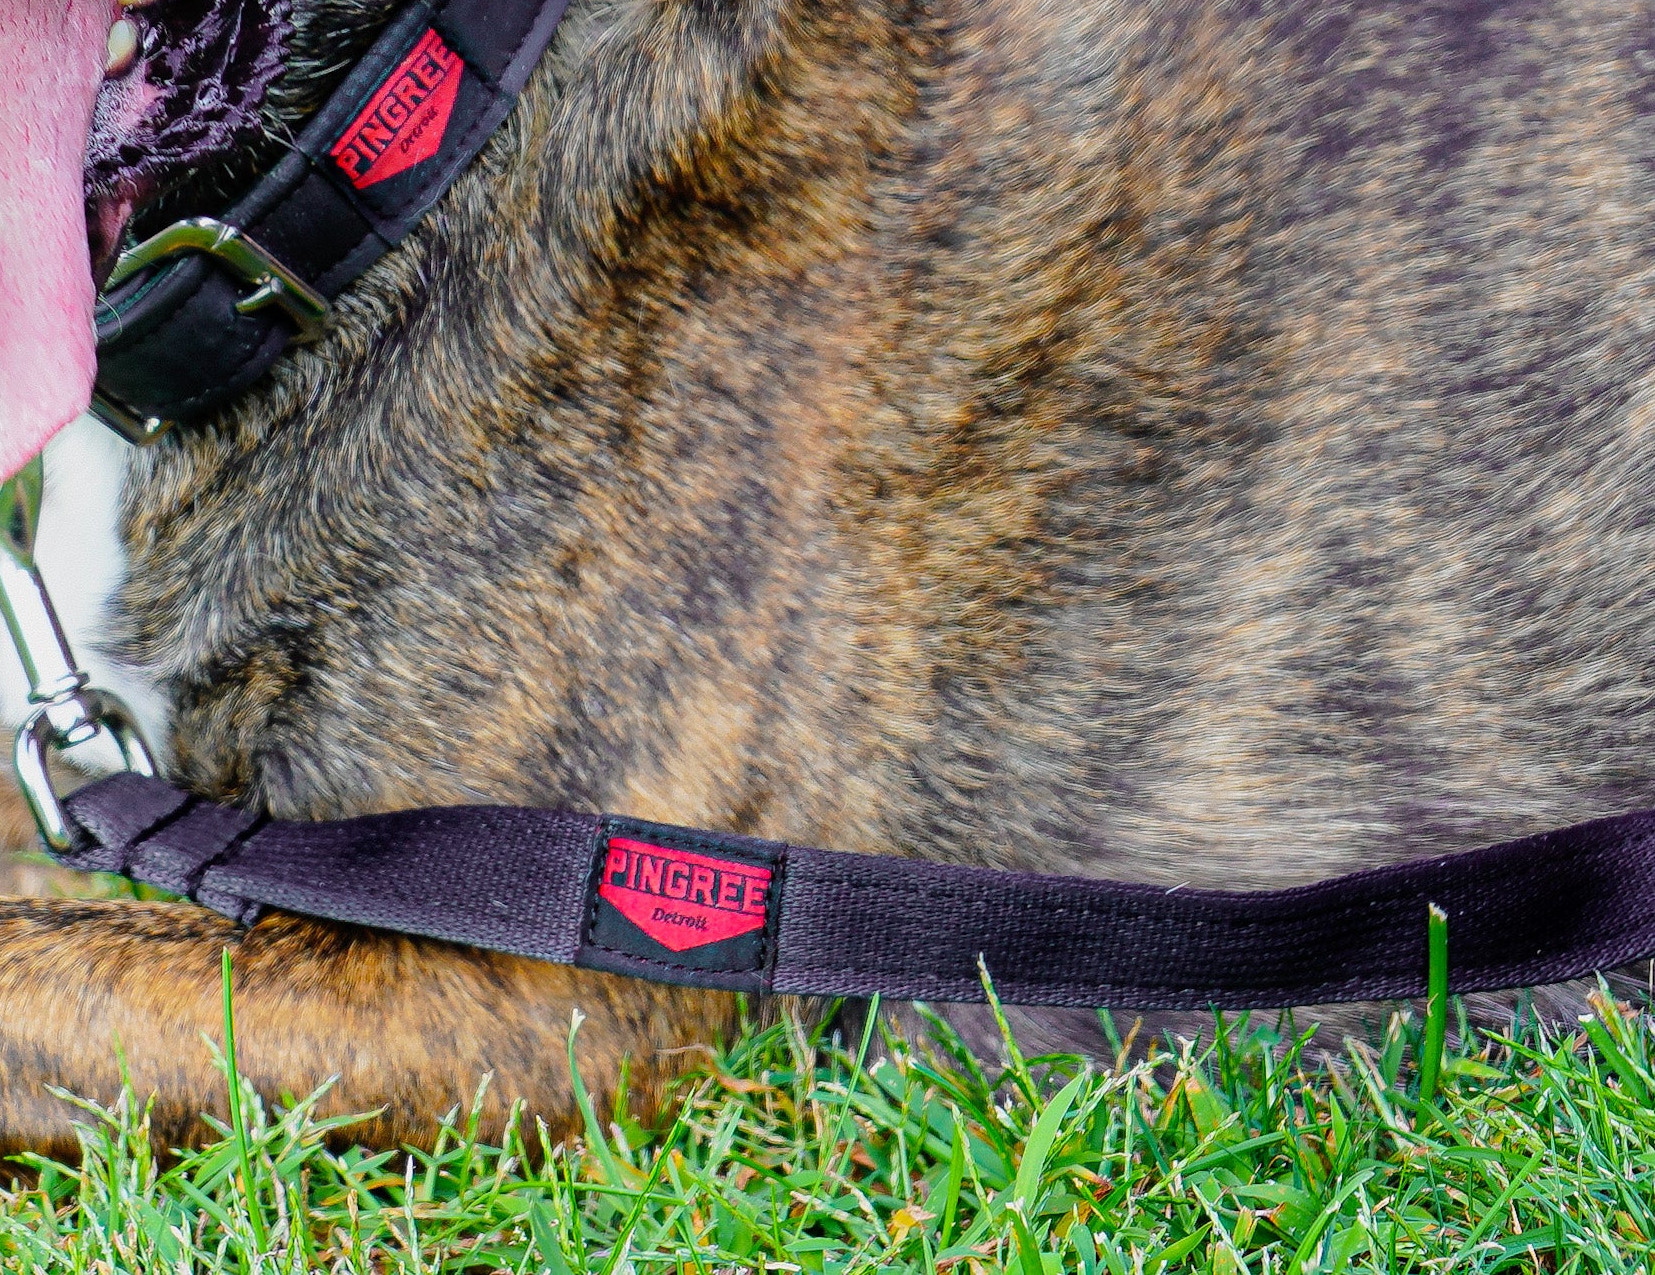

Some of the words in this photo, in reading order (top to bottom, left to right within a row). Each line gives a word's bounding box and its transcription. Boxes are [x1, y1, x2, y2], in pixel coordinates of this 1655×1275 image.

[336, 36, 455, 179] PINGREE
[603, 848, 768, 913] PINGREE
[652, 908, 707, 931] Detroit
